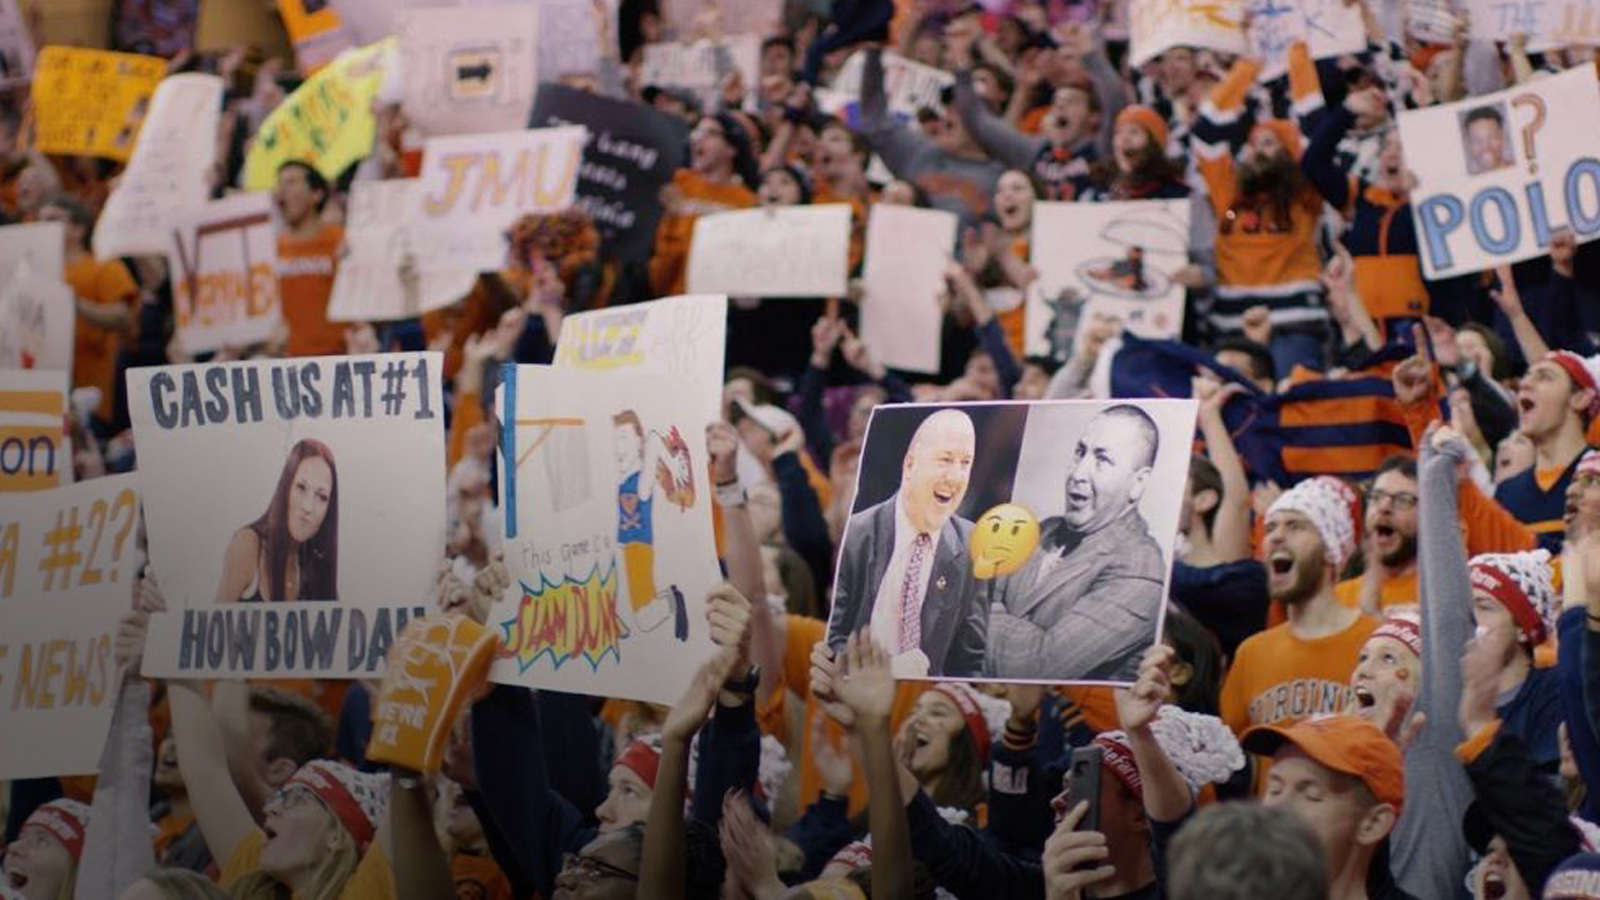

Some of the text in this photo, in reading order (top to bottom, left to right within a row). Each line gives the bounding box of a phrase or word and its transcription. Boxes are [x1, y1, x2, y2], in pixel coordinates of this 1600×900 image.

[1511, 93, 1546, 174] ?
[423, 139, 580, 216] JMU
[1418, 156, 1600, 272] POLO
[151, 357, 435, 430] CASH US AT #1
[39, 488, 136, 592] #2?
[179, 608, 262, 672] HOW
[265, 608, 343, 672] BOW
[498, 594, 567, 659] SLAM
[13, 633, 111, 710] NEWS
